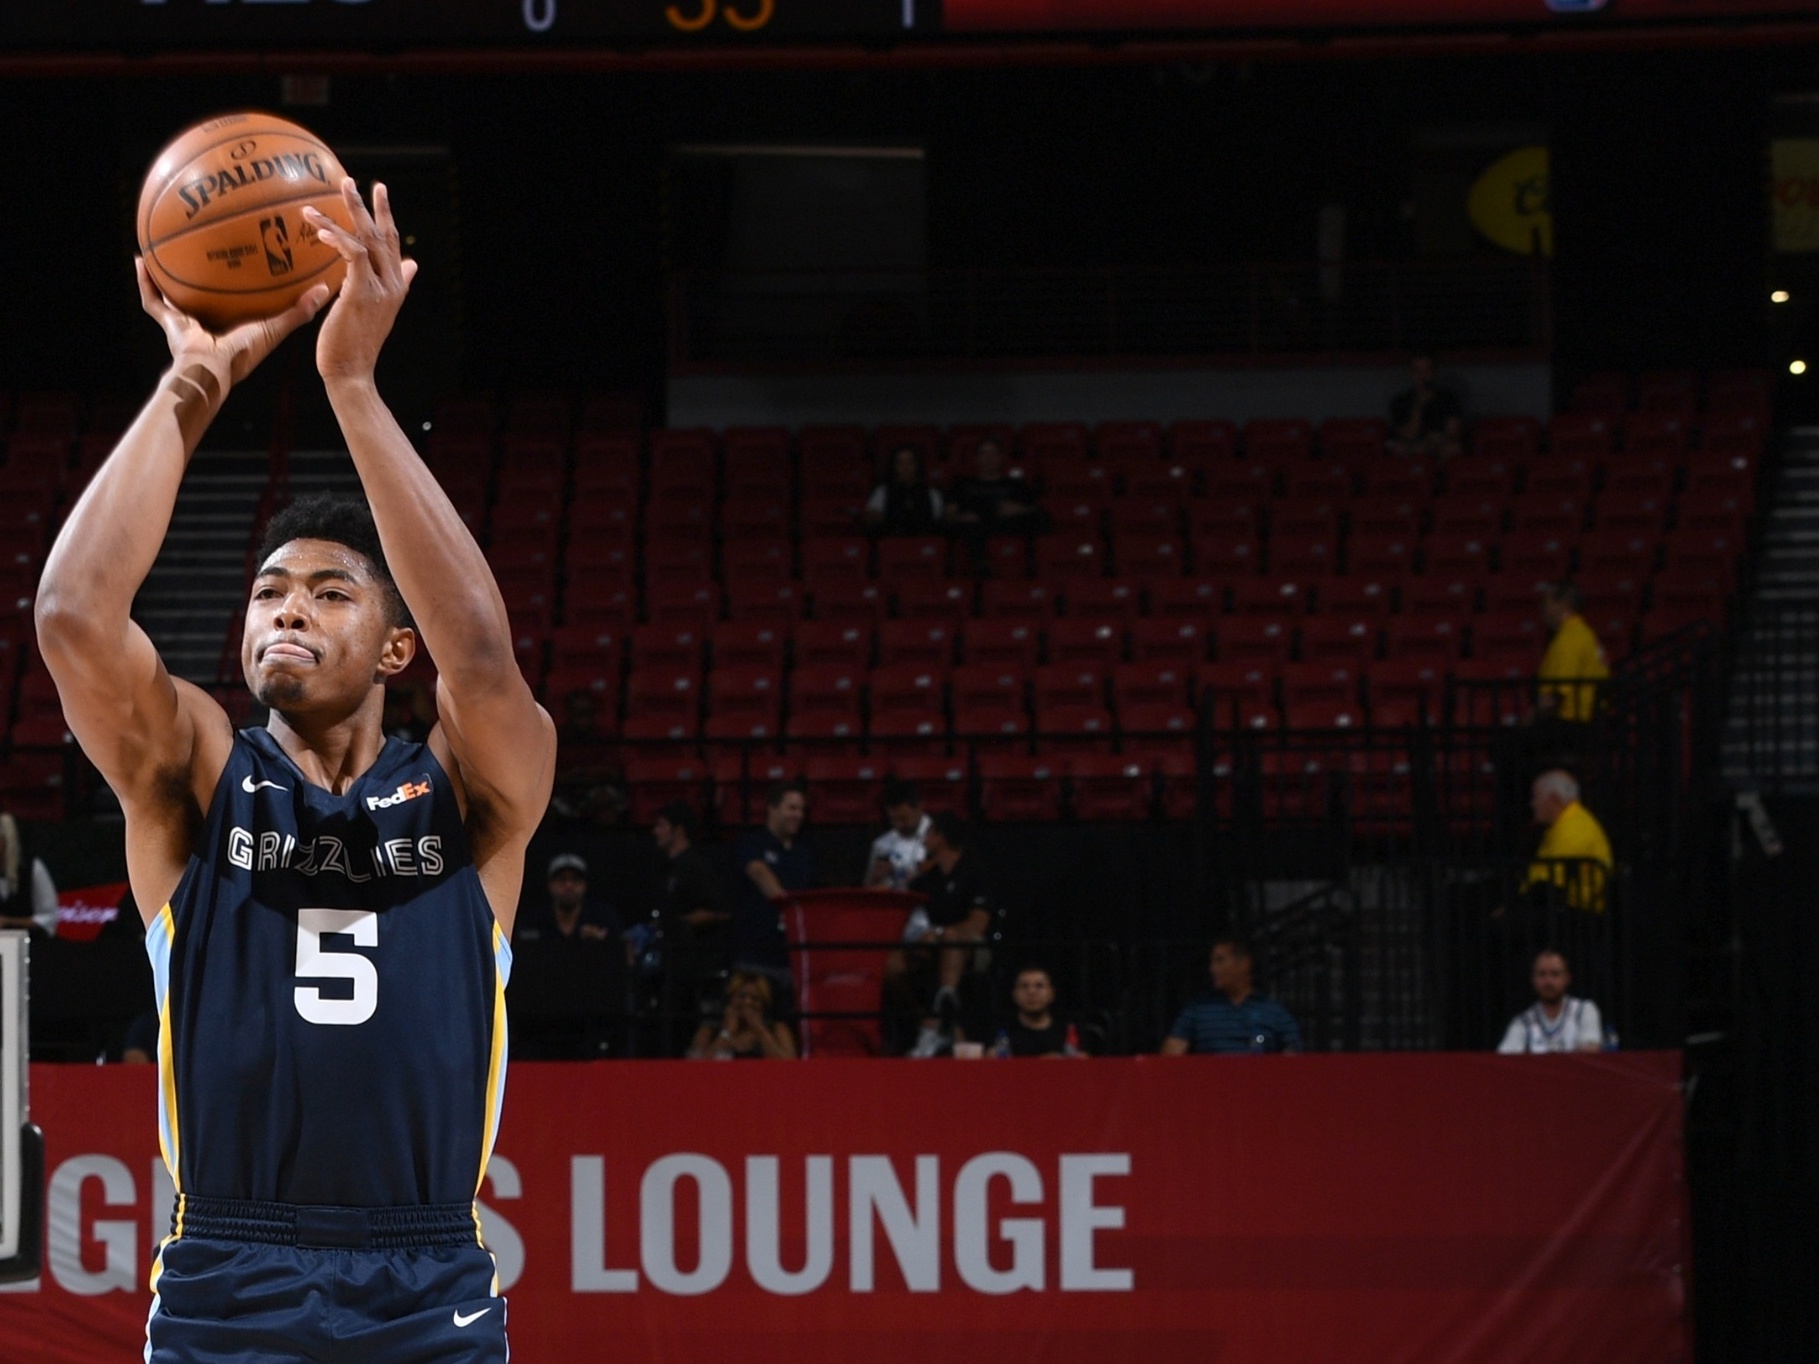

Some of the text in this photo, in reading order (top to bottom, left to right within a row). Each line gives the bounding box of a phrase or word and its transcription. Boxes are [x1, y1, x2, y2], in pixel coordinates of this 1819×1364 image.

[177, 152, 328, 220] SPALDING
[366, 781, 431, 811] FedEx
[227, 826, 445, 883] GRIZZLIES
[293, 908, 379, 1026] 5
[570, 1151, 1135, 1296] LOUNGE
